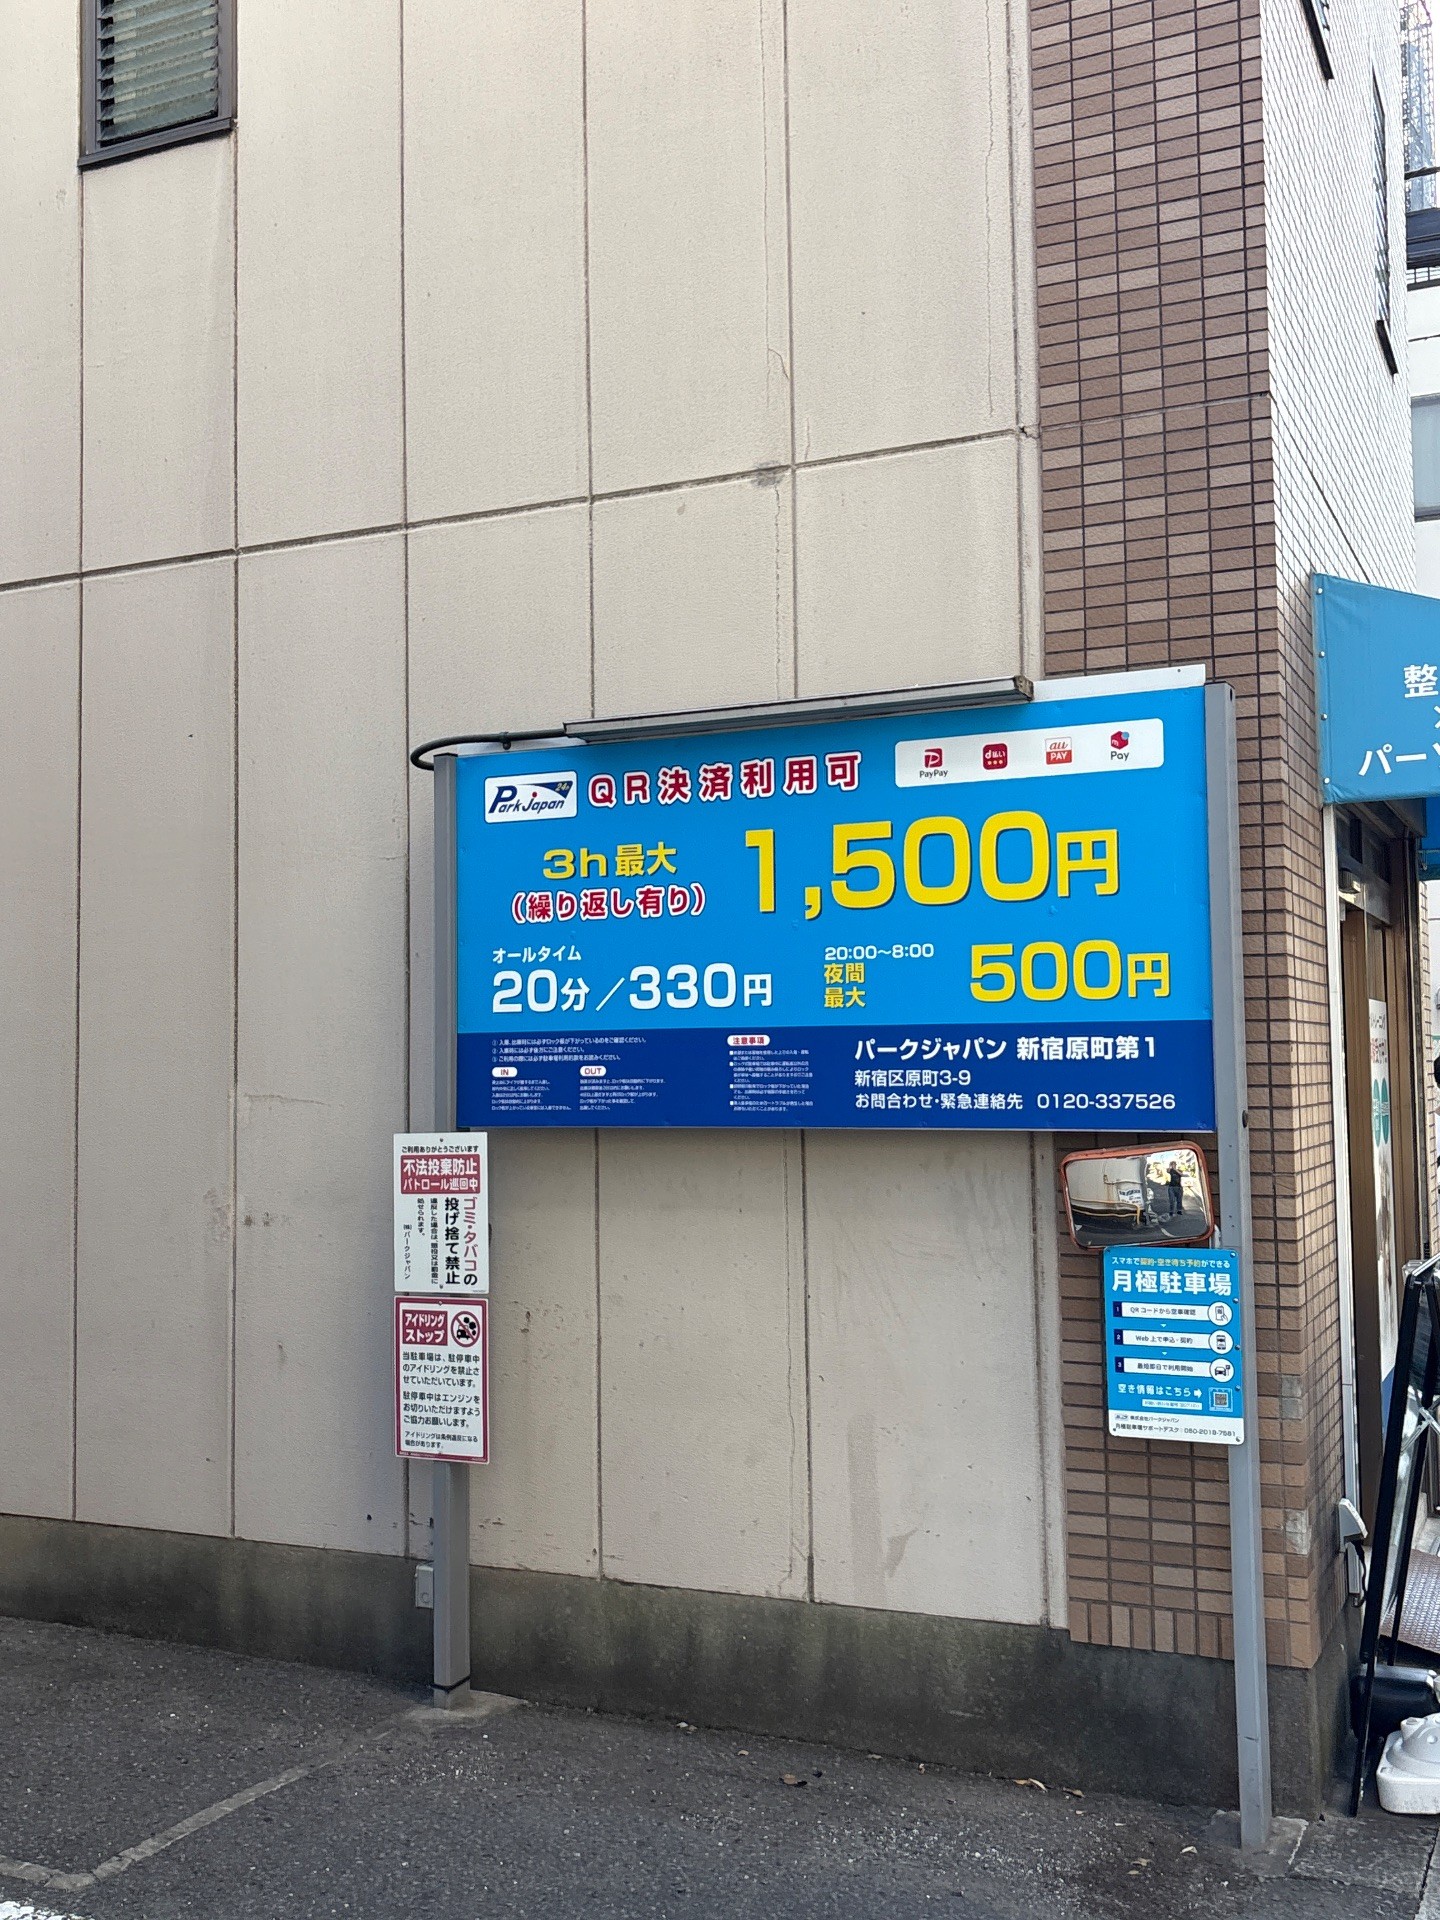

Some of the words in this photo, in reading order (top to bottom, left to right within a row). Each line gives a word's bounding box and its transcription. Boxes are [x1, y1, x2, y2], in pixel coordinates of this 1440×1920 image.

[1403, 663, 1439, 698] 整
[1050, 751, 1069, 761] PAY
[1110, 750, 1130, 762] Pay
[1358, 743, 1440, 776] パー
[590, 751, 861, 807] QR決済利用可
[919, 768, 948, 779] PayPay
[542, 842, 677, 879] 3h最大
[745, 811, 1119, 920] 1,500円
[492, 945, 582, 964] オールタイム
[823, 962, 866, 984] 夜間
[970, 939, 1171, 1003] 500円
[823, 986, 867, 1008] 最大
[854, 1037, 1007, 1060] パークジャパン
[1016, 1035, 1156, 1060] 新宿原町第1
[500, 1068, 509, 1076] IN
[584, 1067, 602, 1075] OUT
[854, 1069, 972, 1087] 新宿区原町3-9
[1037, 1093, 1176, 1110] 0120-337526
[401, 1145, 478, 1153] ご利用ありがとうございます
[403, 1157, 477, 1175] 不法投棄防止
[403, 1177, 478, 1191] パトロール巡回中
[444, 1197, 460, 1284] 投げ捨て禁止
[1111, 1269, 1231, 1295] 月極駐車場
[404, 1313, 445, 1327] アイドリング
[405, 1329, 444, 1343] ストップ
[402, 1351, 479, 1363] 当駐車場は、駐停車中
[402, 1364, 479, 1375] のアイドリングを禁止さ
[403, 1376, 475, 1387] せていただいています。
[1117, 1383, 1190, 1396] 空き情報はこちら
[402, 1391, 480, 1403] 駐停車中はエンジンを
[403, 1403, 480, 1416] お切りいただけますよう
[403, 1415, 469, 1427] ご協力お願いします。
